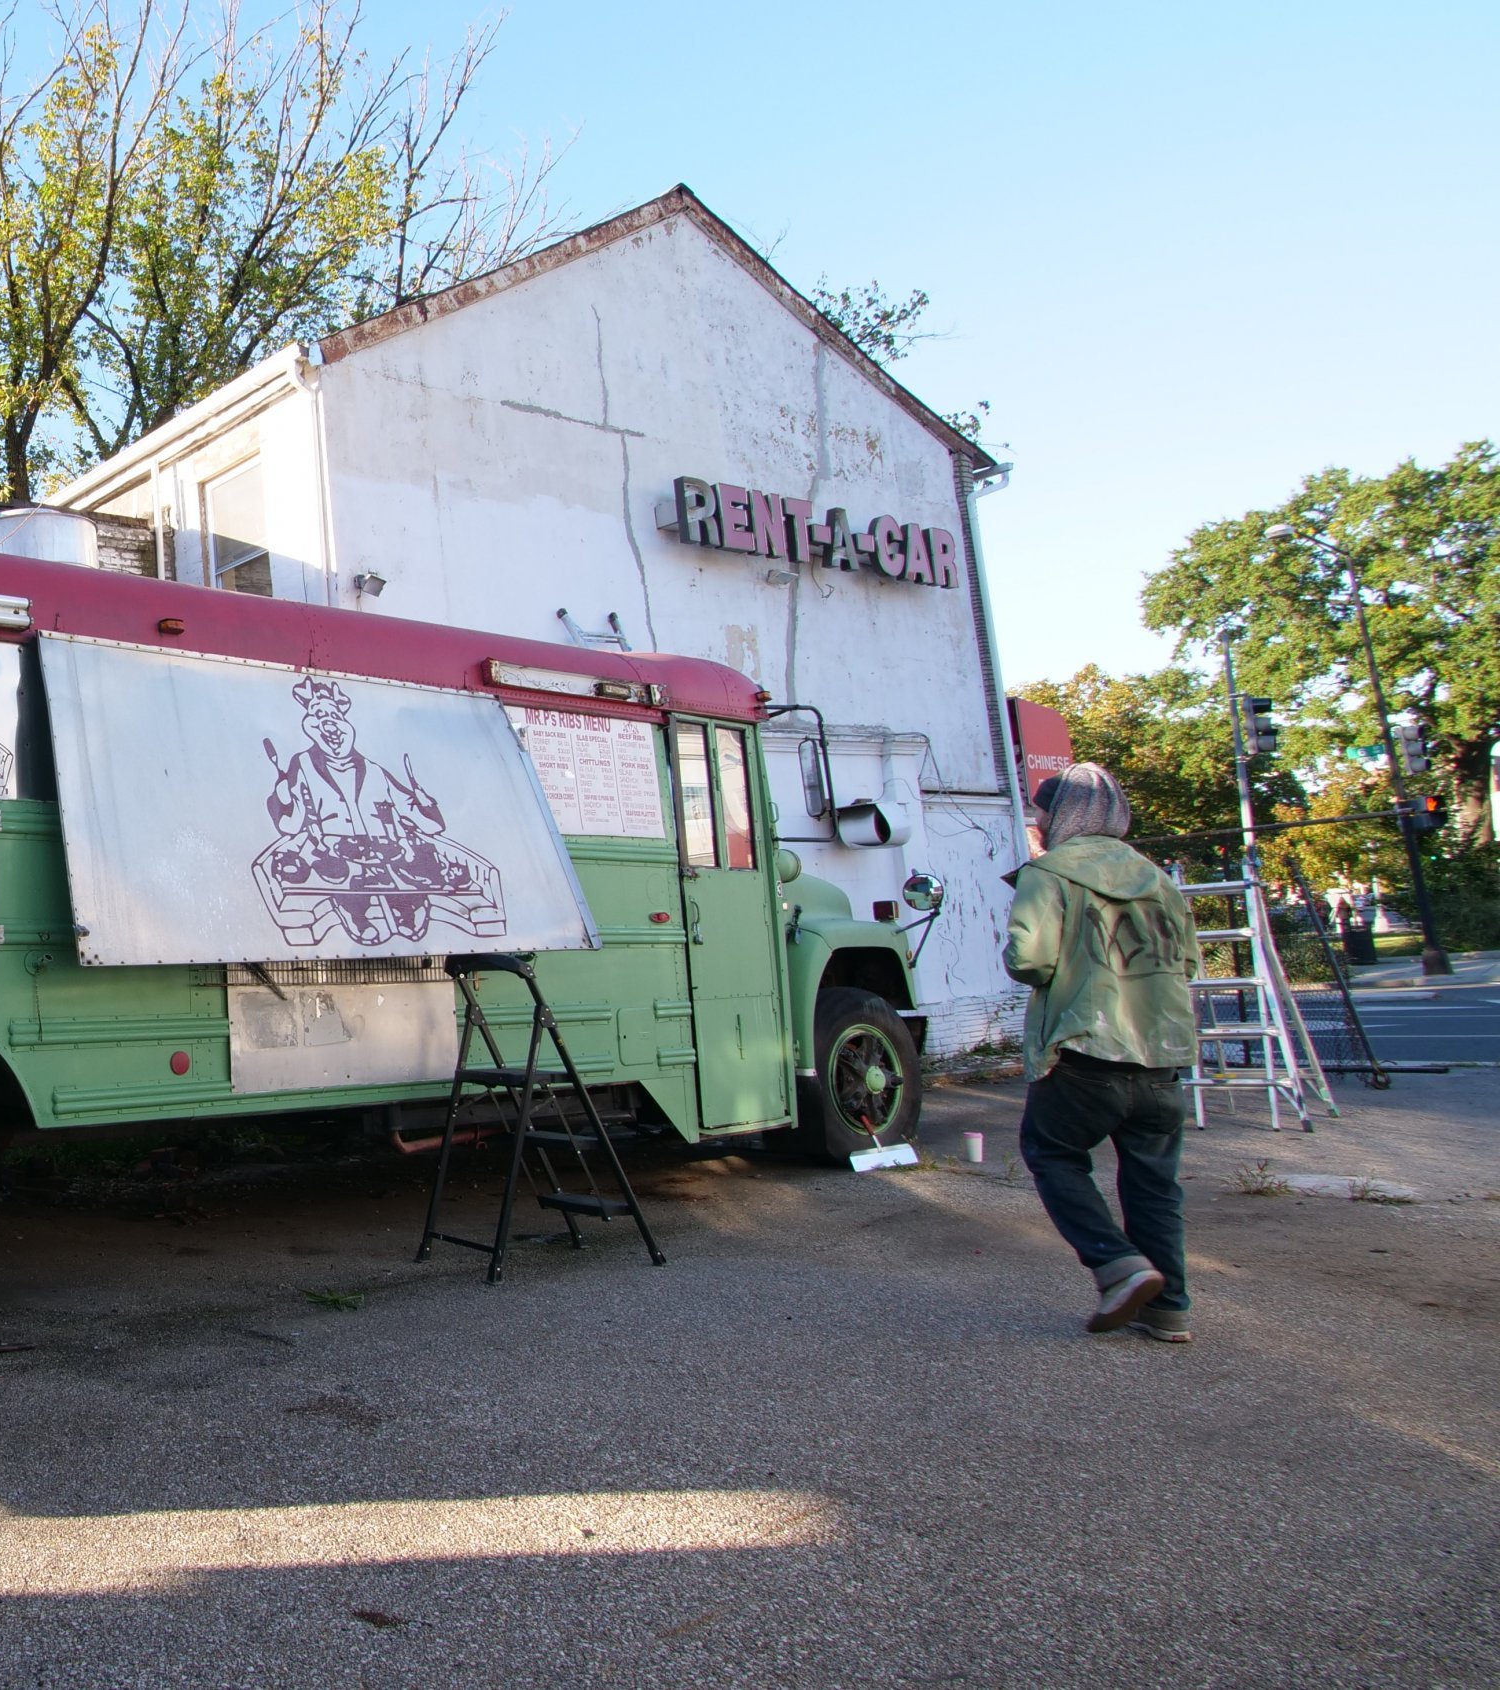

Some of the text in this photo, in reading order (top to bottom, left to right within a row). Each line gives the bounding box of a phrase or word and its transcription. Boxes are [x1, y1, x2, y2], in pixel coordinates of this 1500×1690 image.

[673, 475, 959, 589] RENT-A-CAR
[559, 712, 582, 729] RIBS
[583, 715, 611, 733] MENU
[1027, 754, 1070, 771] CHINESE
